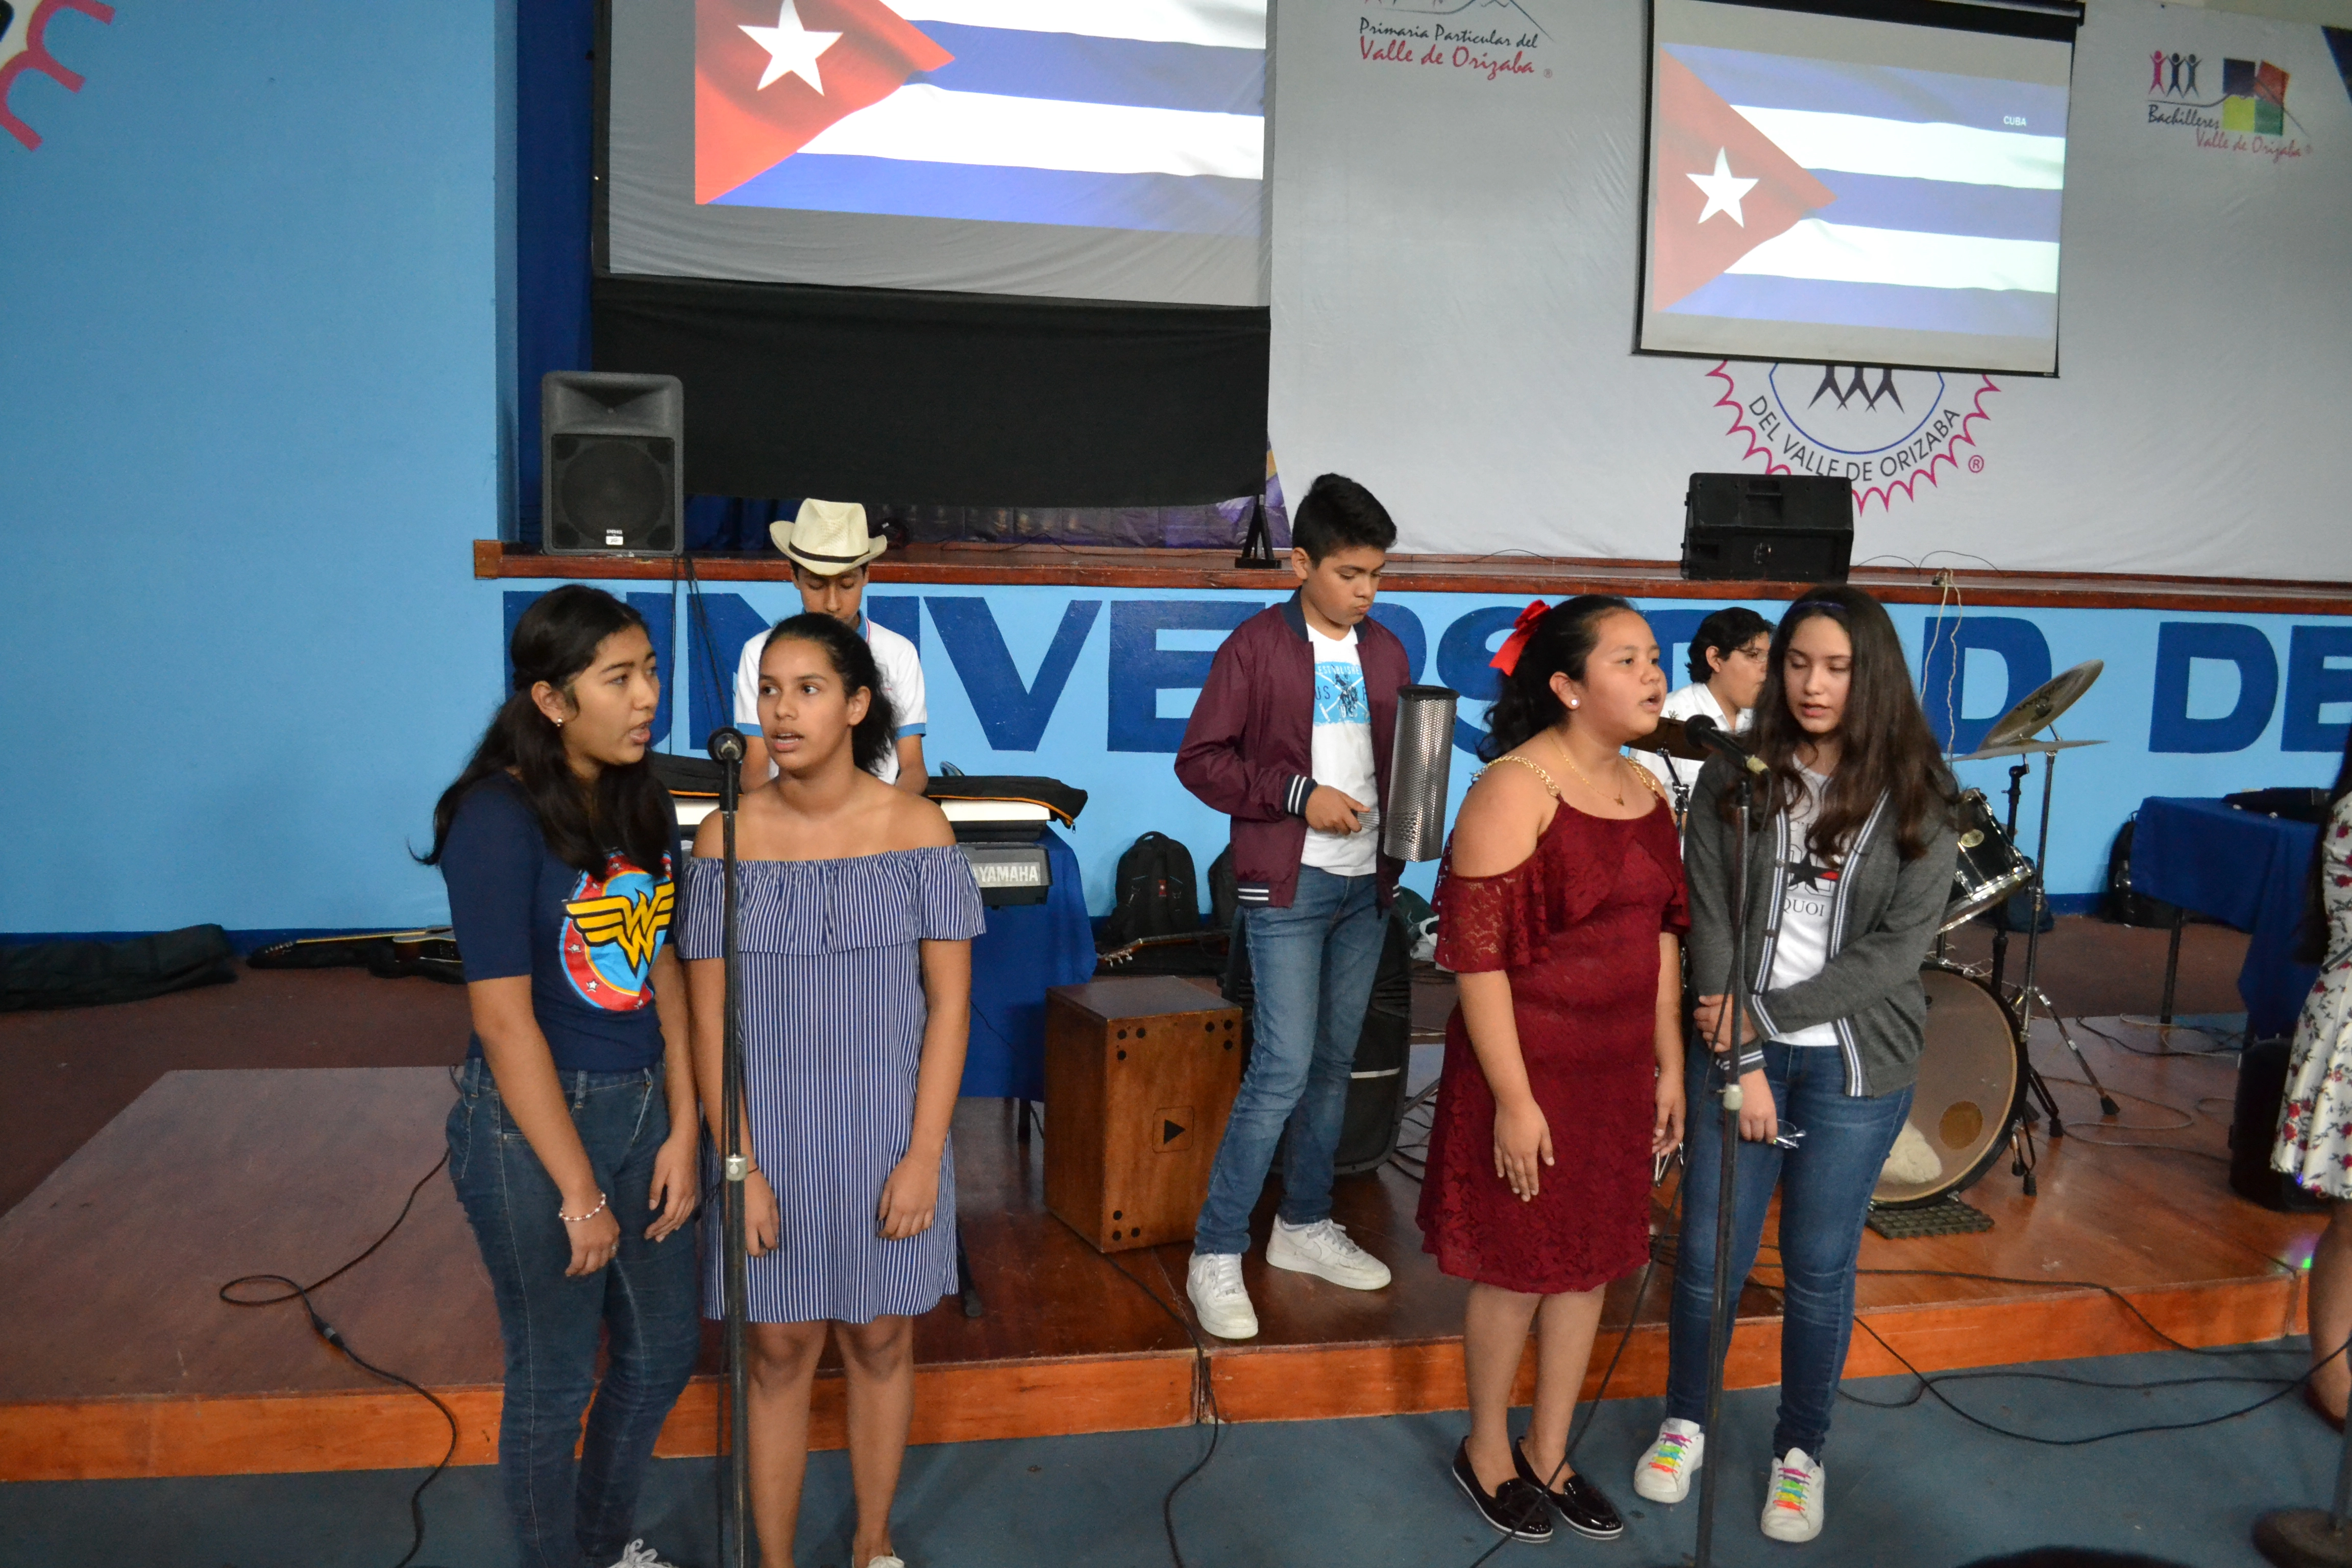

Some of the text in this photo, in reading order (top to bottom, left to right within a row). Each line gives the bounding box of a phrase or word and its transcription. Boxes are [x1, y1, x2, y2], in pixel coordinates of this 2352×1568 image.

[1359, 17, 1538, 48] Primaria Particular del
[1360, 36, 1413, 61] Valle
[1421, 44, 1443, 65] de
[1452, 45, 1534, 81] Orizaba
[2003, 115, 2027, 127] CUBA
[2148, 104, 2220, 130] Bachilleres
[2196, 128, 2228, 149] Valle
[1749, 395, 1782, 442] DEL
[1782, 433, 1840, 476] VALLE
[1846, 461, 1872, 481] DE
[1879, 408, 1961, 477] ORIZABA
[979, 866, 1039, 883] YAMAHA
[1783, 897, 1826, 917] QUOI
